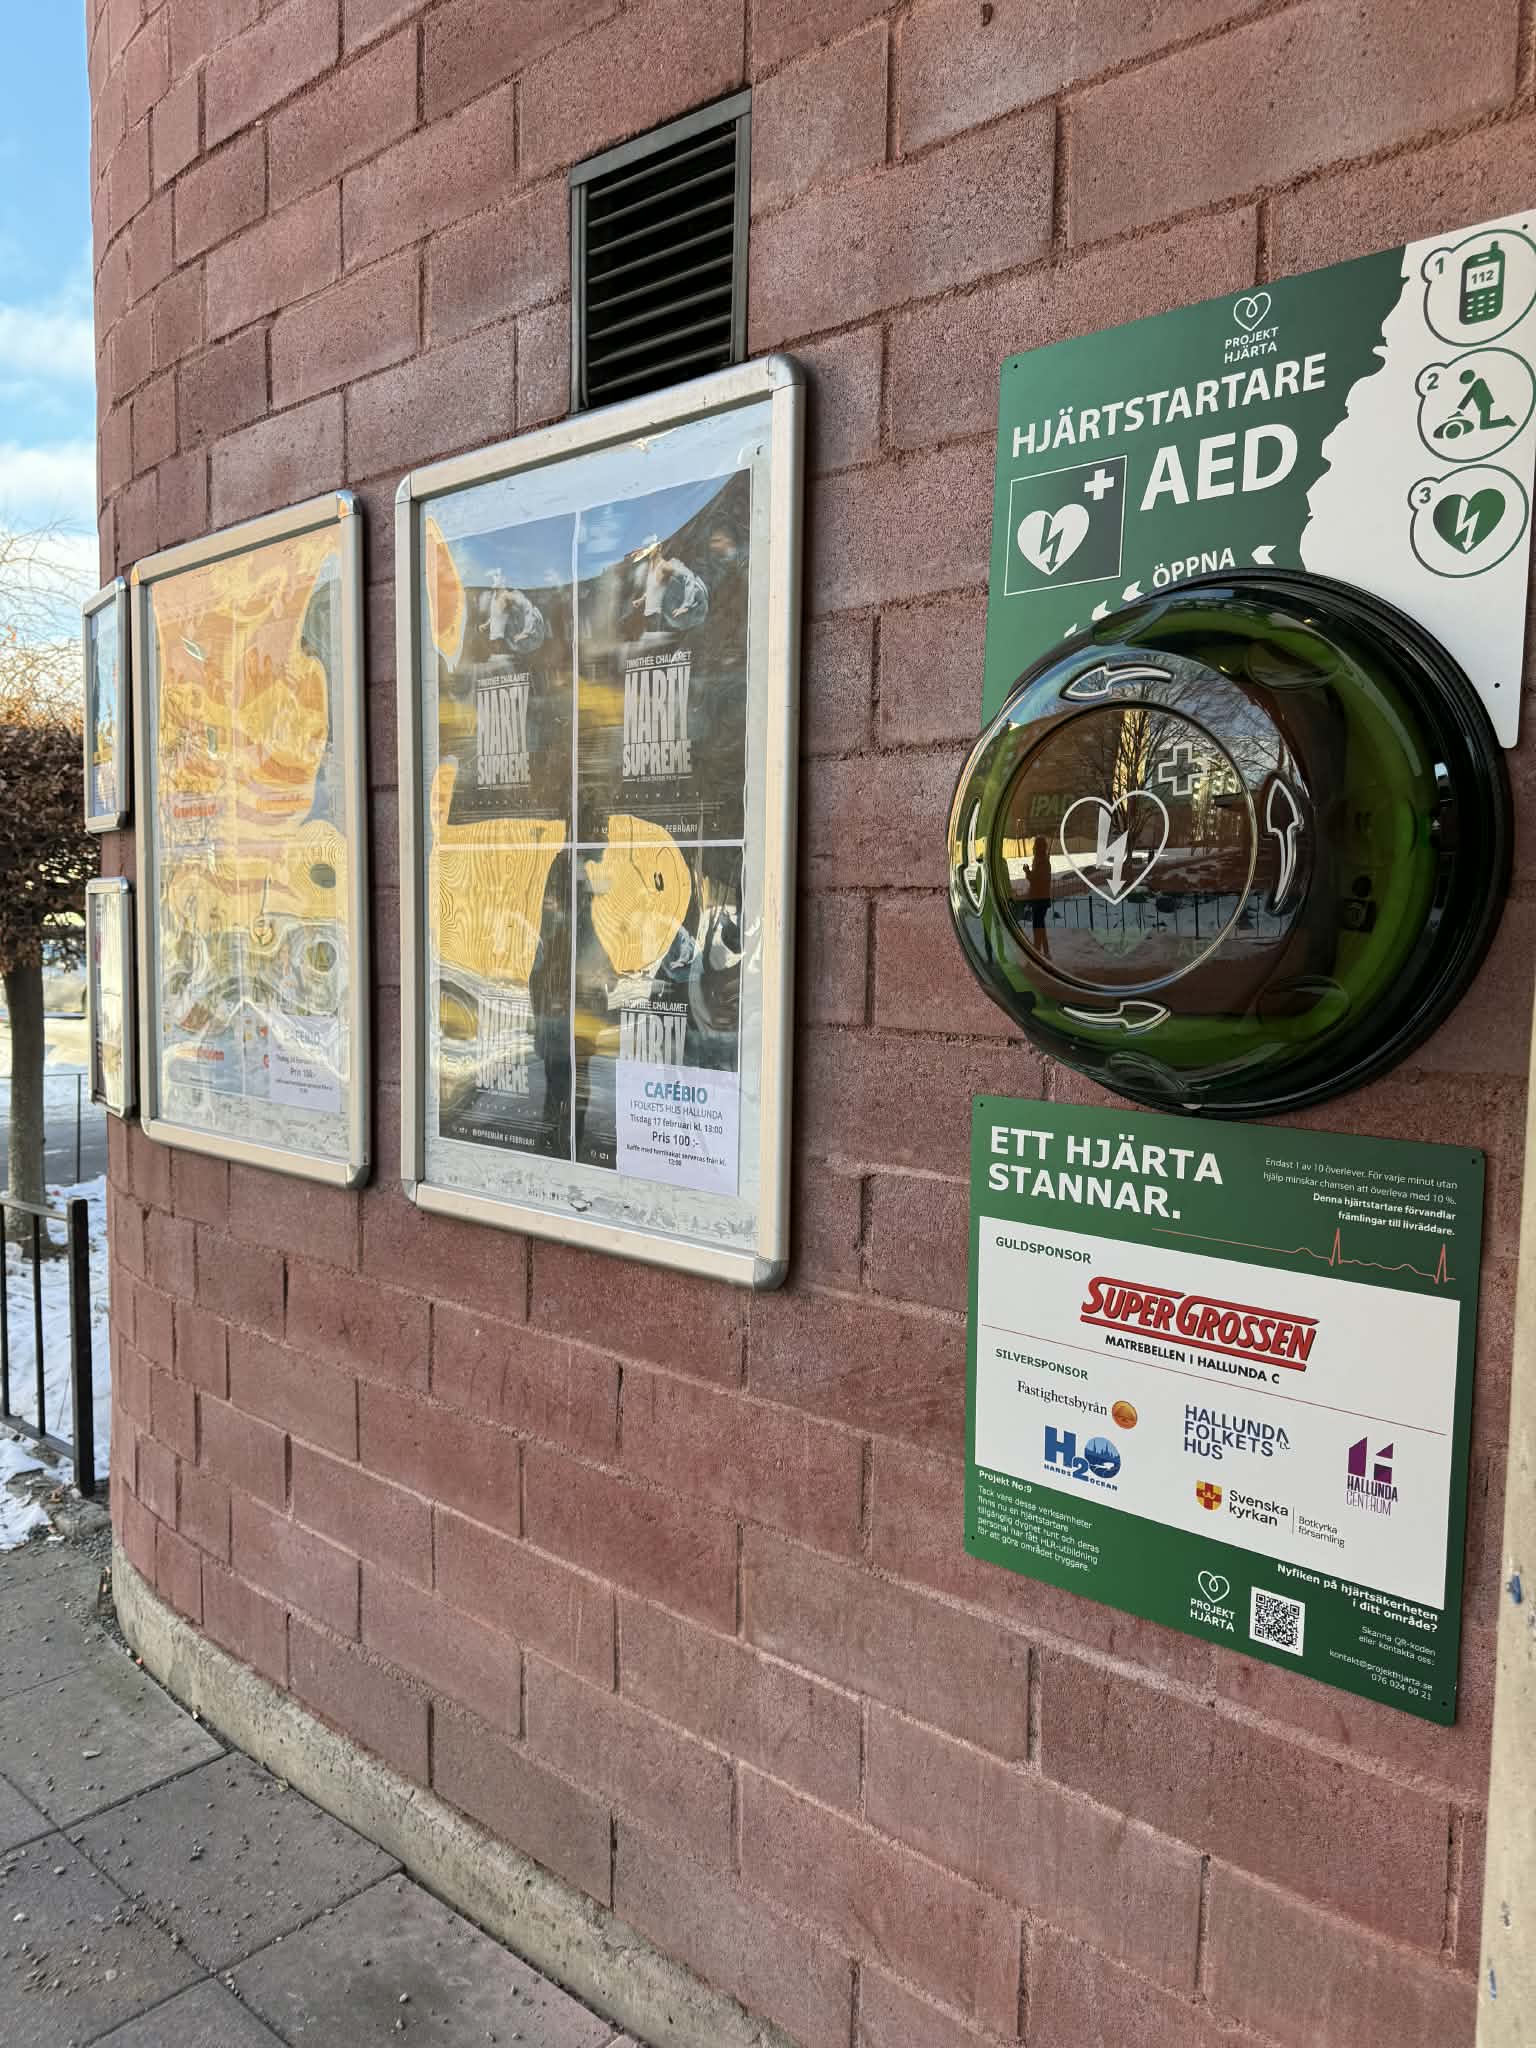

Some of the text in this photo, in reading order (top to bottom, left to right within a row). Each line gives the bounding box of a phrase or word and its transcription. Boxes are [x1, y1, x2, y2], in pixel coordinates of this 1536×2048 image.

[1435, 256, 1445, 275] 1
[1471, 270, 1495, 284] 112
[1225, 326, 1279, 348] PROJEKT
[1224, 342, 1278, 364] HJÄRTA
[1427, 373, 1440, 391] 2
[1012, 352, 1327, 458] HJÄRTSTARTARE
[1140, 423, 1298, 512] AED
[1419, 487, 1432, 504] 3
[1152, 547, 1236, 589] ÖPPNA
[623, 666, 691, 744] MARTY
[477, 751, 531, 785] SUPREME
[622, 739, 692, 777] SUPREME
[620, 1011, 688, 1065] MARTY
[644, 1080, 708, 1104] CAFÉBIO
[633, 1100, 664, 1113] FOLKETS
[665, 1105, 681, 1114] HUS
[682, 1106, 723, 1120] HALLUNDA
[630, 1113, 652, 1126] Tisdag
[653, 1117, 661, 1126] 17
[662, 1118, 692, 1131] februari
[704, 1124, 723, 1135] 13:00
[652, 1131, 671, 1144] Pris
[673, 1134, 690, 1147] 100
[991, 1125, 1224, 1185] ETT HJÄRTA
[1265, 1157, 1293, 1169] Endast
[1302, 1163, 1312, 1171] av
[1314, 1163, 1324, 1173] 10
[1368, 1170, 1383, 1180] För
[1384, 1173, 1406, 1184] varje
[1407, 1176, 1434, 1187] minut
[1436, 1180, 1458, 1190] utan
[988, 1162, 1181, 1220] STANNAR.
[1263, 1171, 1284, 1183] hjälp
[1285, 1175, 1319, 1187] minskar
[1319, 1179, 1355, 1191] chansen
[1357, 1185, 1368, 1193] att
[1370, 1186, 1408, 1199] överleva
[1409, 1191, 1430, 1201] med
[1433, 1194, 1444, 1203] 10
[1313, 1192, 1457, 1220] Denna hjärtstartare förvandlar
[1338, 1210, 1456, 1236] främlingar till livräddare.
[995, 1236, 1092, 1264] GULDSPONSOR
[995, 1348, 1089, 1381] SILVERSPONSOR
[1105, 1335, 1186, 1363] MATREBELLEN
[1197, 1356, 1268, 1382] HALLUNDA
[1271, 1372, 1280, 1384] C
[1017, 1380, 1108, 1416] Fastighetsbyrån
[1185, 1404, 1290, 1443] HALLUNDA
[1184, 1437, 1223, 1460] HUS
[1185, 1421, 1274, 1457] FOLKETS
[979, 1470, 1032, 1493] Projekt No:9
[1044, 1463, 1071, 1477] HANDS
[1089, 1477, 1118, 1491] OCEAN
[1346, 1475, 1399, 1502] HALLUNDA
[978, 1495, 996, 1508] finns
[998, 1503, 1008, 1512] nu
[1010, 1506, 1019, 1516] en
[978, 1485, 994, 1496] Tack
[1038, 1505, 1093, 1529] verksamheter
[1228, 1501, 1278, 1527] kyrkan
[1229, 1489, 1289, 1517] Svenska
[1346, 1490, 1392, 1516] CENTRUM
[1298, 1525, 1345, 1548] församling
[1299, 1515, 1338, 1535] Botkyrka
[1077, 1539, 1100, 1554] deras
[1277, 1563, 1438, 1622] Nyfiken på hjärtsäkerheten
[1190, 1598, 1236, 1620] PROJEKT
[1190, 1609, 1235, 1633] HJÄRTA
[1359, 1600, 1381, 1616] ditt
[1383, 1608, 1438, 1633] område?
[1358, 1635, 1376, 1646] eller
[1378, 1641, 1415, 1659] kontakta
[1361, 1626, 1392, 1642] Skanna
[1371, 1673, 1388, 1686] 076
[1389, 1679, 1406, 1692] 024
